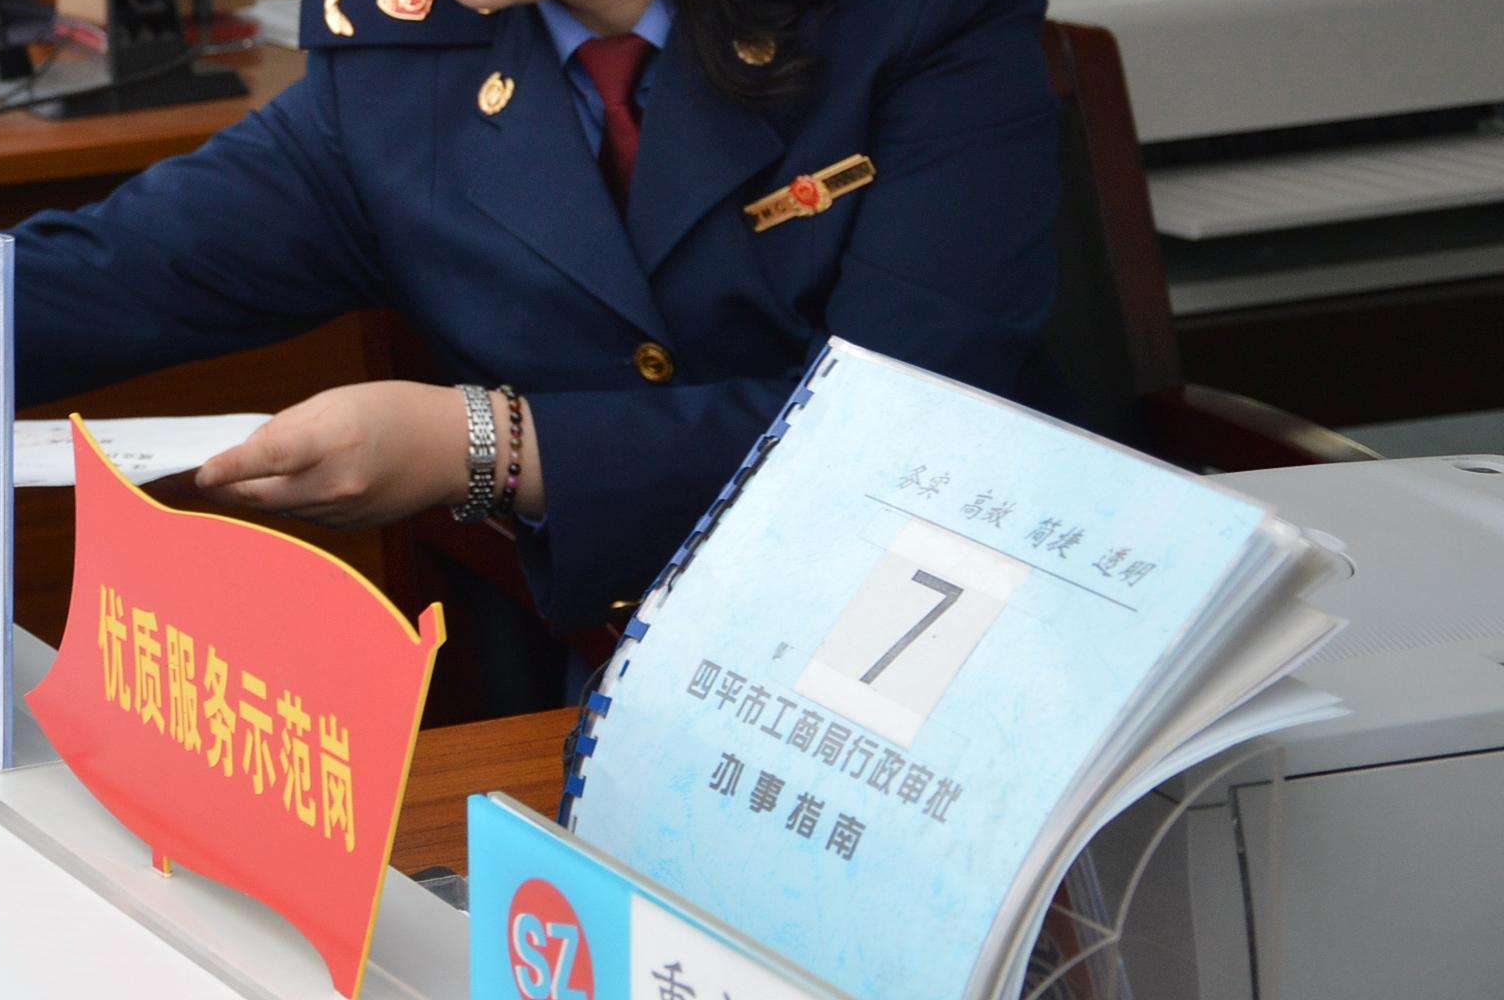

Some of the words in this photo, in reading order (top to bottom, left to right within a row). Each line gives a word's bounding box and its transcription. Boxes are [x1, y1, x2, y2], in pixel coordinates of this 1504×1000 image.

[959, 489, 1017, 529] 高效
[1092, 547, 1157, 588] 透明
[859, 569, 964, 685] 7
[98, 584, 356, 852] 优质服务示范岗
[686, 659, 964, 824] 四平市工商局行政审批
[708, 752, 867, 862] 办事指南
[512, 912, 588, 1000] SZ
